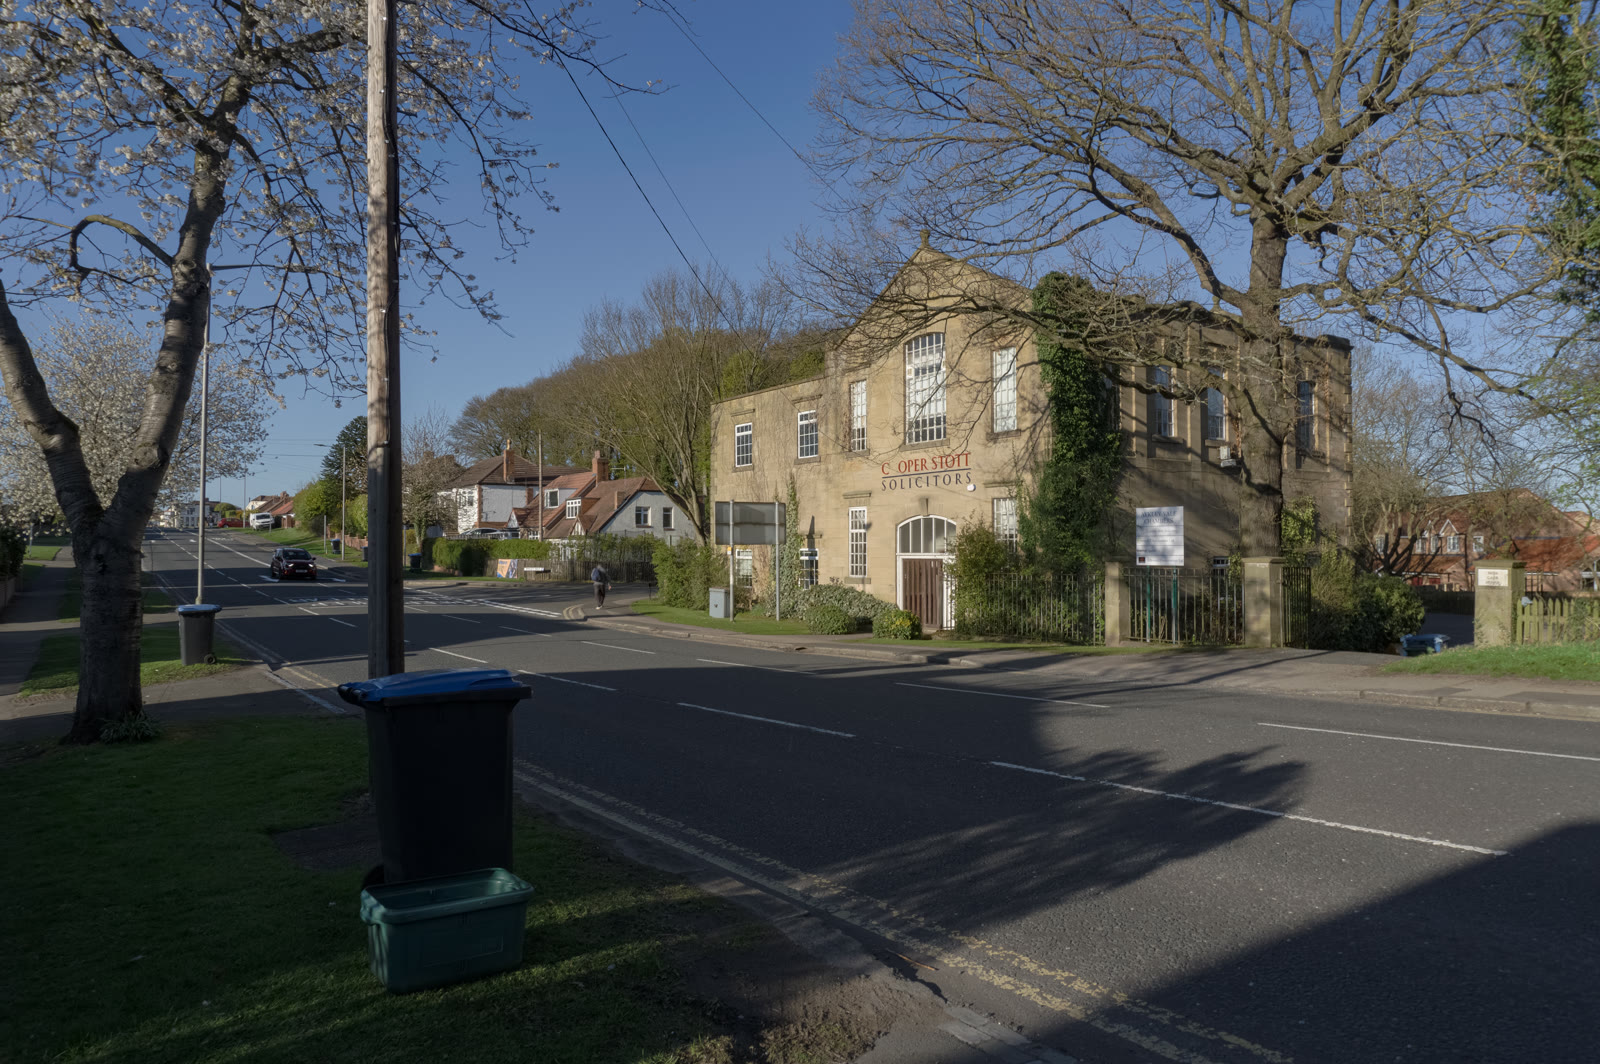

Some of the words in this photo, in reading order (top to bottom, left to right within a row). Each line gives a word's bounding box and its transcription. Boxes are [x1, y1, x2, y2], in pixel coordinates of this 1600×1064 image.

[881, 458, 929, 475] COPER
[931, 452, 971, 470] STOTT
[881, 472, 972, 491] SOLICITORS
